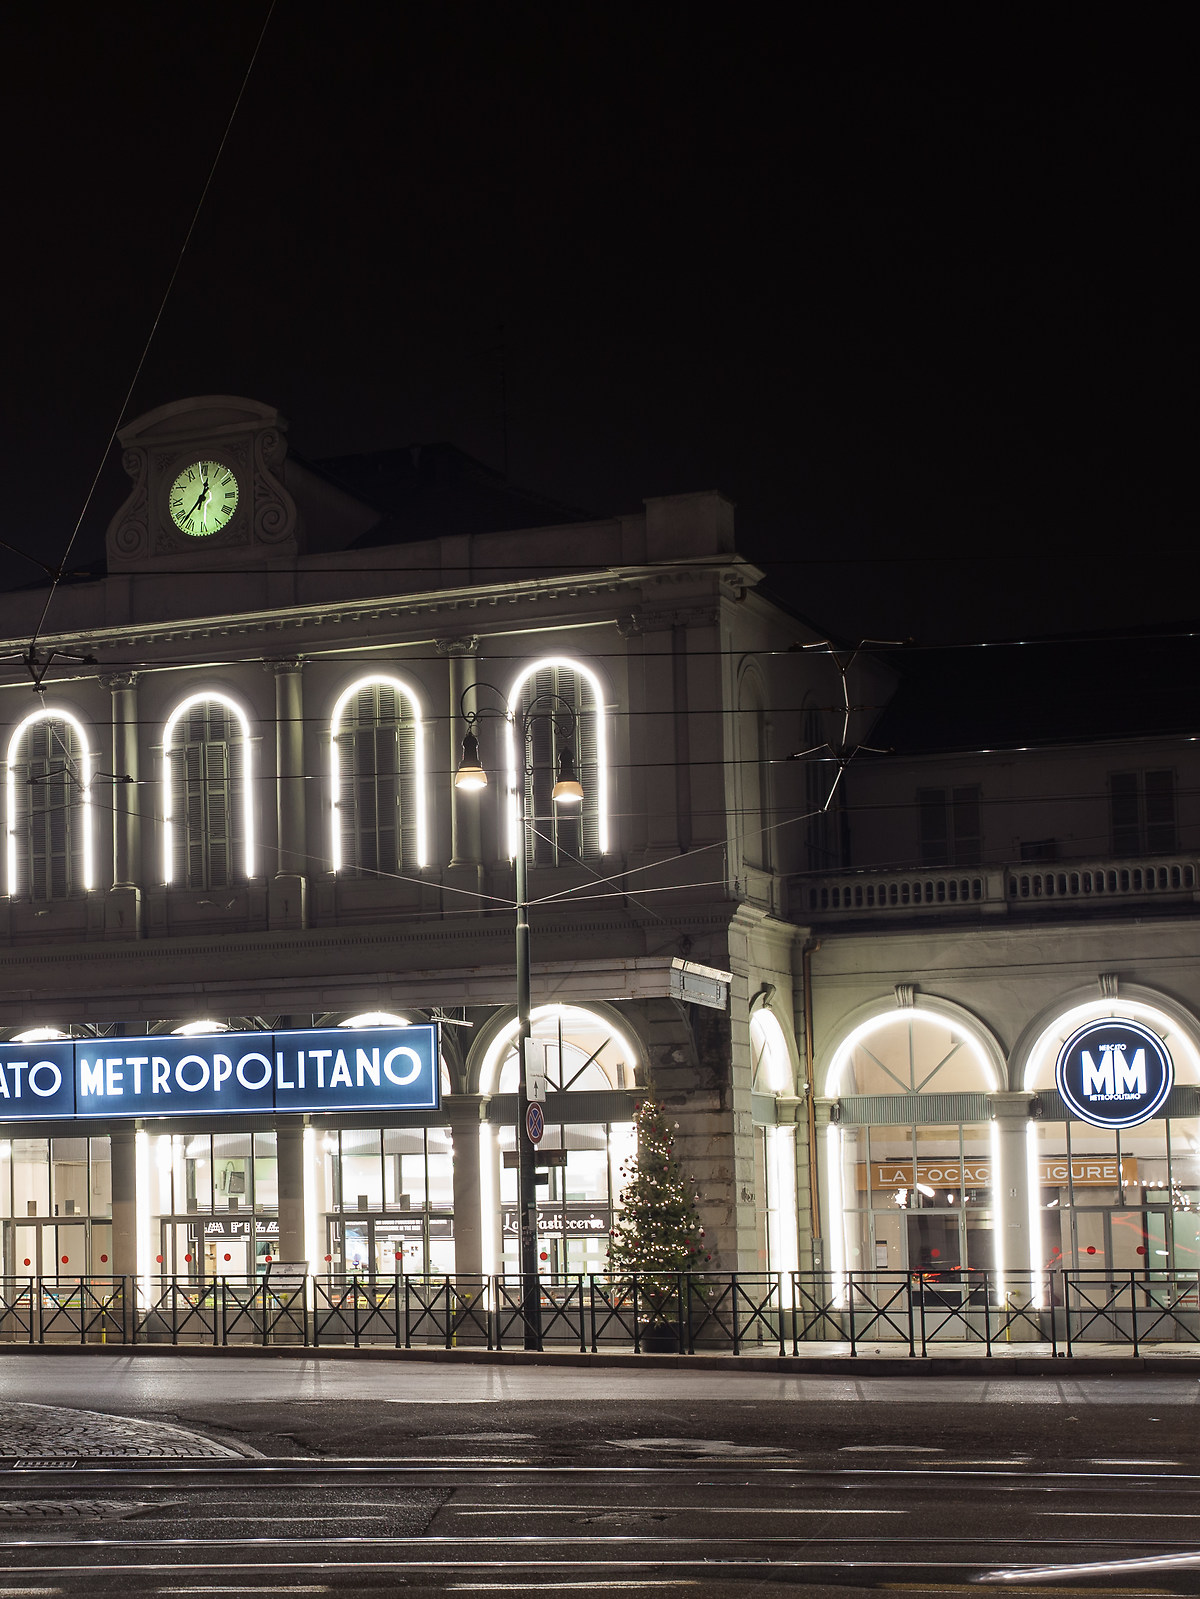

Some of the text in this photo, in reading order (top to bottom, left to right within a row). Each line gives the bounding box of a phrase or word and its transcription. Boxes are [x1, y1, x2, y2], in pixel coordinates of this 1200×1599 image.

[80, 1046, 422, 1097] METROPOLITANO
[1081, 1048, 1147, 1095] MM
[879, 1168, 907, 1182] LA
[915, 1167, 991, 1181] FOCAC
[230, 1221, 280, 1234] PIZZ
[537, 1212, 605, 1230] asticceria
